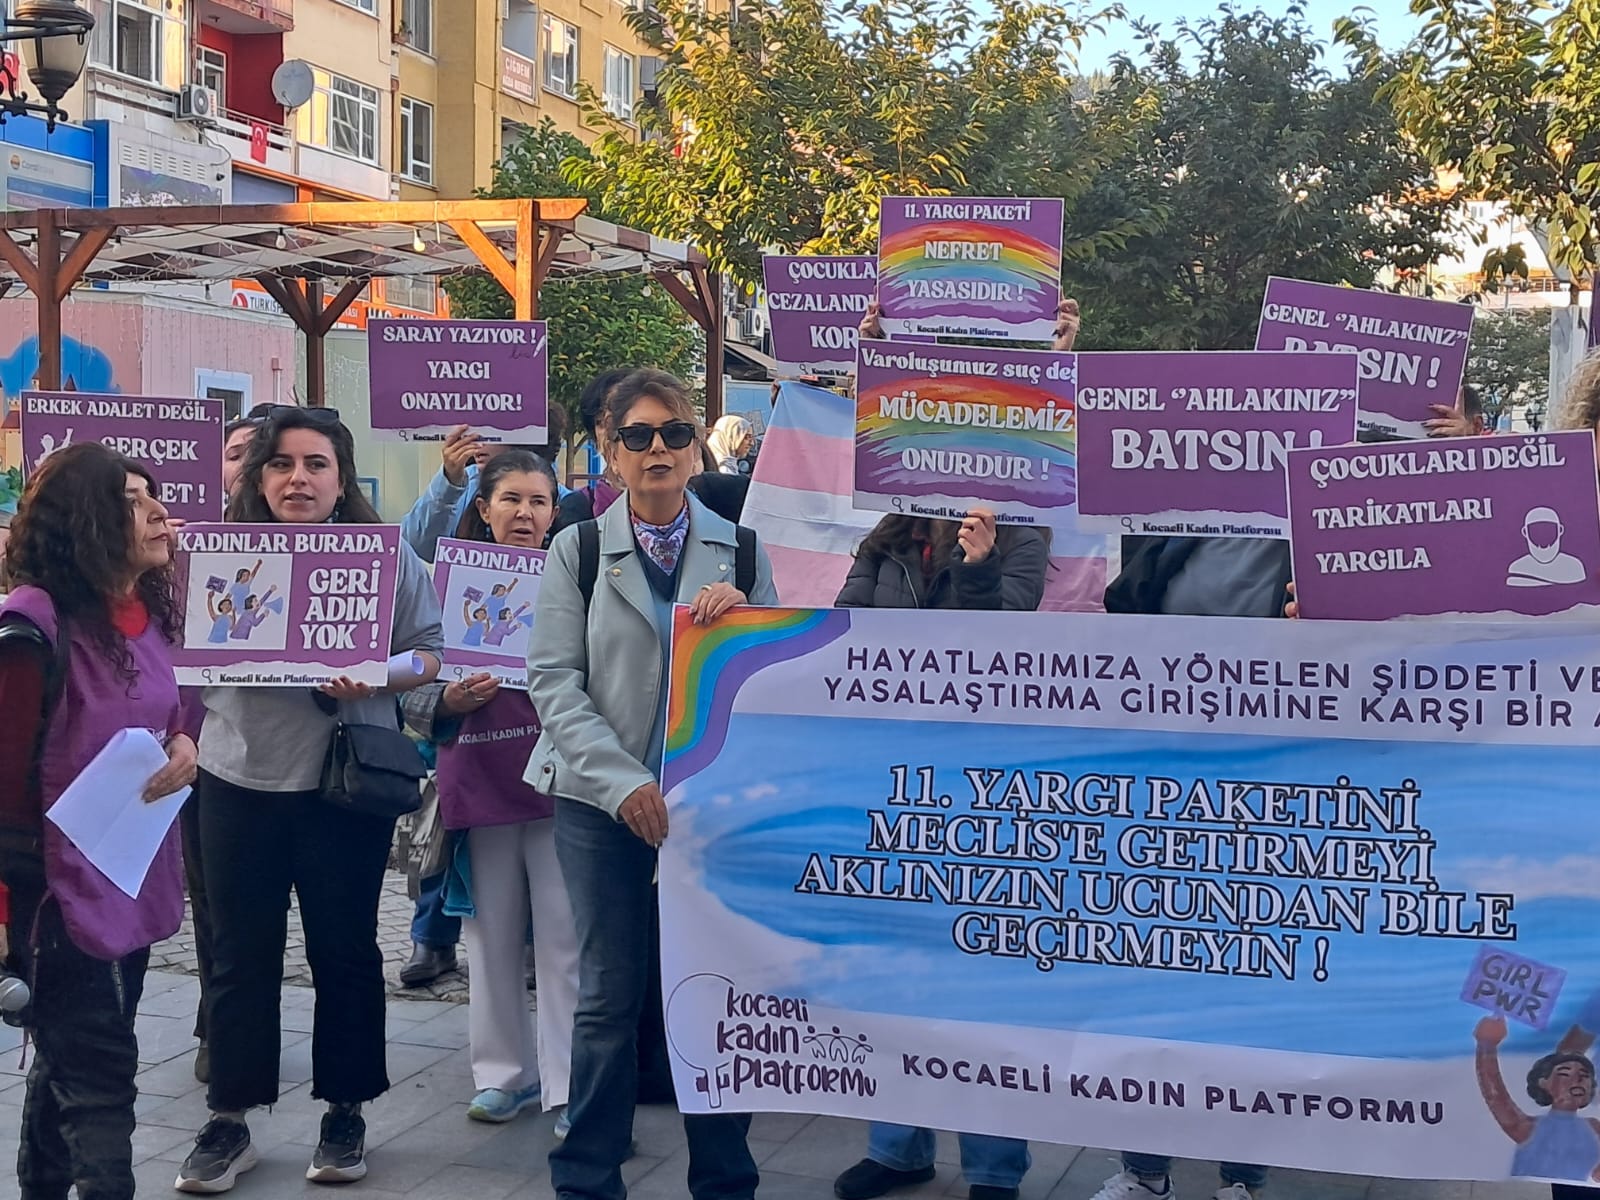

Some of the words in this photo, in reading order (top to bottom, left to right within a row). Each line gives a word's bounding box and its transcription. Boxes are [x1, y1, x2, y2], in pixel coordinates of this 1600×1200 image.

[922, 204, 970, 220] YARGI
[972, 201, 1031, 221] PAKETİ
[924, 240, 1003, 262] NEFRET
[788, 261, 876, 284] ÇOCUKLA
[907, 279, 1012, 302] YASASIDIR
[1264, 303, 1329, 328] GENEL
[383, 326, 444, 342] SARAY
[449, 327, 527, 344] YAZIYOR
[810, 325, 859, 350] KOR
[427, 360, 490, 379] YARGI
[861, 348, 998, 377] Varoluşumuz
[1002, 364, 1041, 383] suç
[27, 398, 83, 416] ERKEK
[86, 400, 156, 419] ADALET
[158, 401, 210, 422] DEĞİL
[401, 391, 522, 411] ONAYLIYOR!
[879, 390, 1073, 432] MÜCADELEMİZ
[1078, 387, 1165, 411] GENEL
[1112, 428, 1296, 472] BATSIN
[1310, 448, 1476, 488] ÇOCUKLARI
[1482, 436, 1566, 471] DEĞİL
[902, 448, 1034, 481] ONURDUR
[911, 504, 946, 517] Kocaeli
[1312, 498, 1493, 530] TARİKATLARI
[1142, 522, 1184, 533] Kocaeli
[1186, 522, 1220, 534] Kadın
[1222, 524, 1282, 536] Platformu
[178, 532, 290, 552] KADINLAR
[294, 533, 384, 553] BURADA
[437, 546, 544, 575] KADINLAR
[1315, 547, 1432, 574] YARGILA
[308, 560, 381, 595] GERİ
[304, 596, 377, 622] ADIM
[300, 624, 358, 650] YOK
[219, 674, 253, 683] Kocaeli
[255, 674, 282, 684] Kadın
[284, 674, 330, 684] Platformu
[847, 647, 1141, 681] HAYATLARIMIZA
[1161, 652, 1350, 690] YÖNELEN
[1373, 659, 1537, 697] ŞİDDETİ
[824, 676, 1102, 713] YASALAŞTIRMA
[1120, 683, 1339, 724] GİRİŞİMİNE
[1361, 696, 1483, 732] KARŞI
[1506, 694, 1572, 728] BİR
[492, 726, 524, 741] KADIN
[887, 764, 952, 809] 11.
[963, 767, 1136, 818] YARGI
[1145, 775, 1422, 834] PAKETİNİ
[866, 810, 1106, 866] MECLİS'E
[1117, 822, 1436, 886] GETİRMEYİ
[794, 852, 1068, 913] AKLINIZIN
[1078, 870, 1371, 934] UCUNDAN
[1380, 882, 1517, 941] BİLE
[953, 908, 1302, 981] GEÇİRMEYİN
[1482, 954, 1549, 999] GIRL
[1472, 980, 1542, 1023] PWR
[902, 1054, 1051, 1094] KOCAELİ
[1070, 1072, 1185, 1108] KADIN
[1205, 1085, 1444, 1125] PLATFORMU
